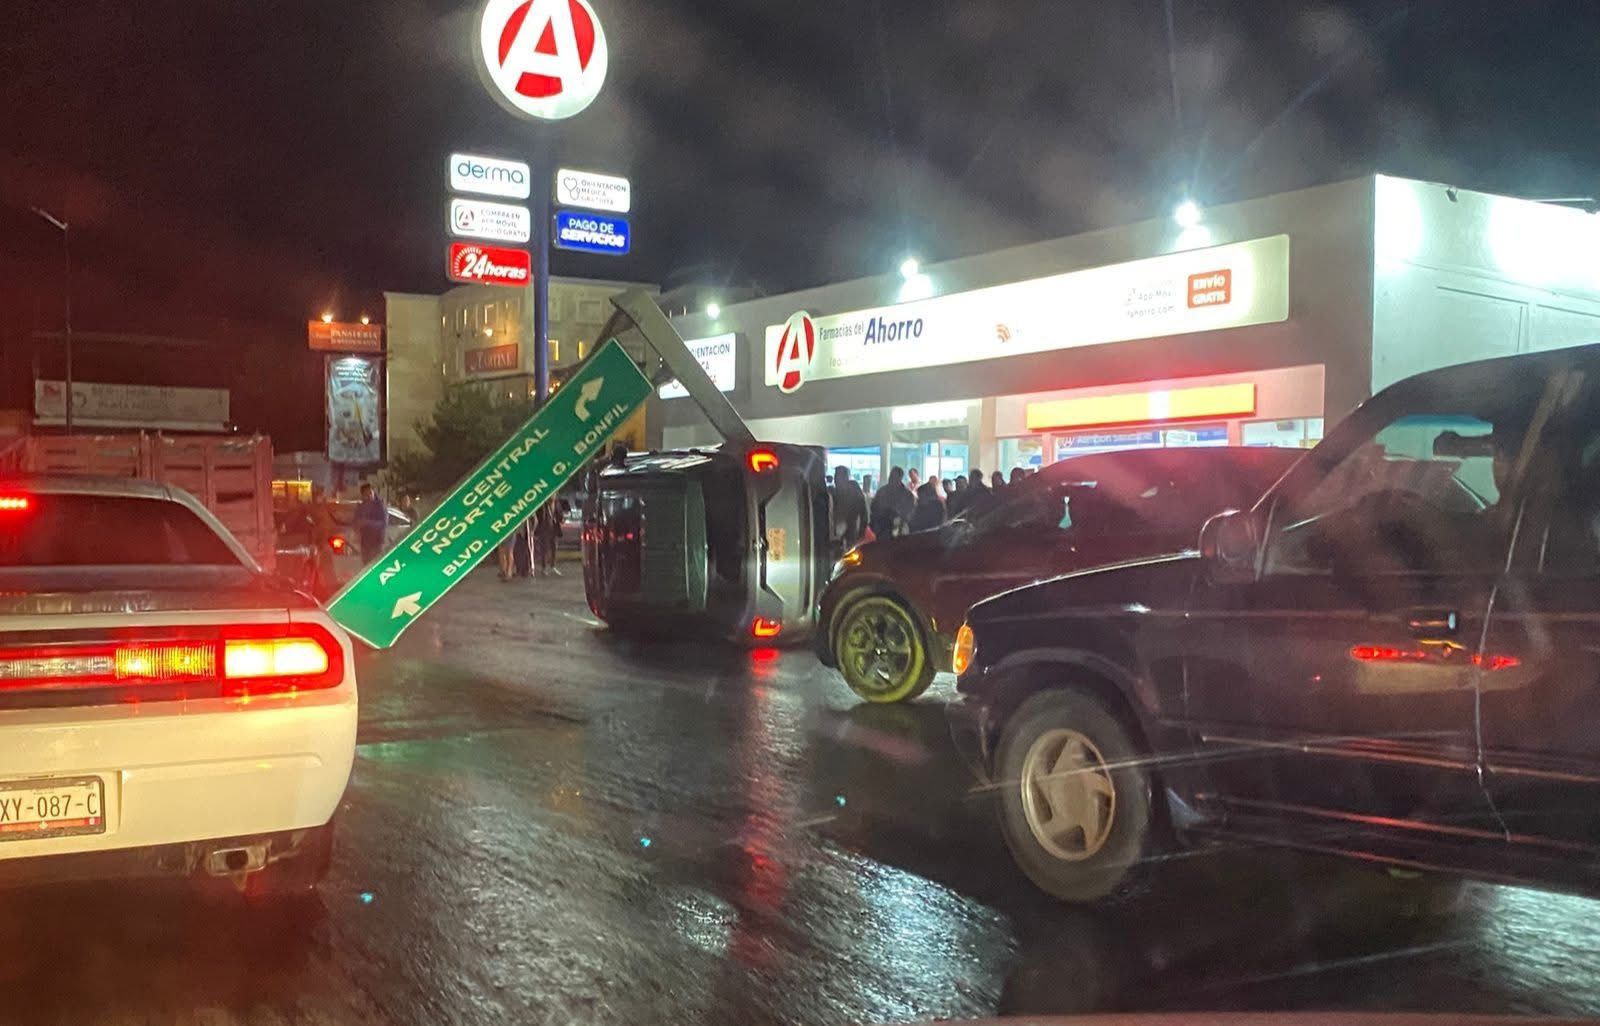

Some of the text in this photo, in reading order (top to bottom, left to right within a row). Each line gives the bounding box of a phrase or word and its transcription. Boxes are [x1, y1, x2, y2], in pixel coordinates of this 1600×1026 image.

[457, 159, 524, 185] derma
[560, 227, 626, 248] SERVICIOS
[568, 218, 615, 235] PAGO DE
[819, 315, 925, 346] Farmacias del Ahorro
[442, 403, 629, 577] BLVD. RAMON G. BONFIL
[379, 428, 550, 586] AV. FCC. CENTRAL
[431, 481, 513, 555] NORTE
[0, 792, 97, 822] XY-087-C
